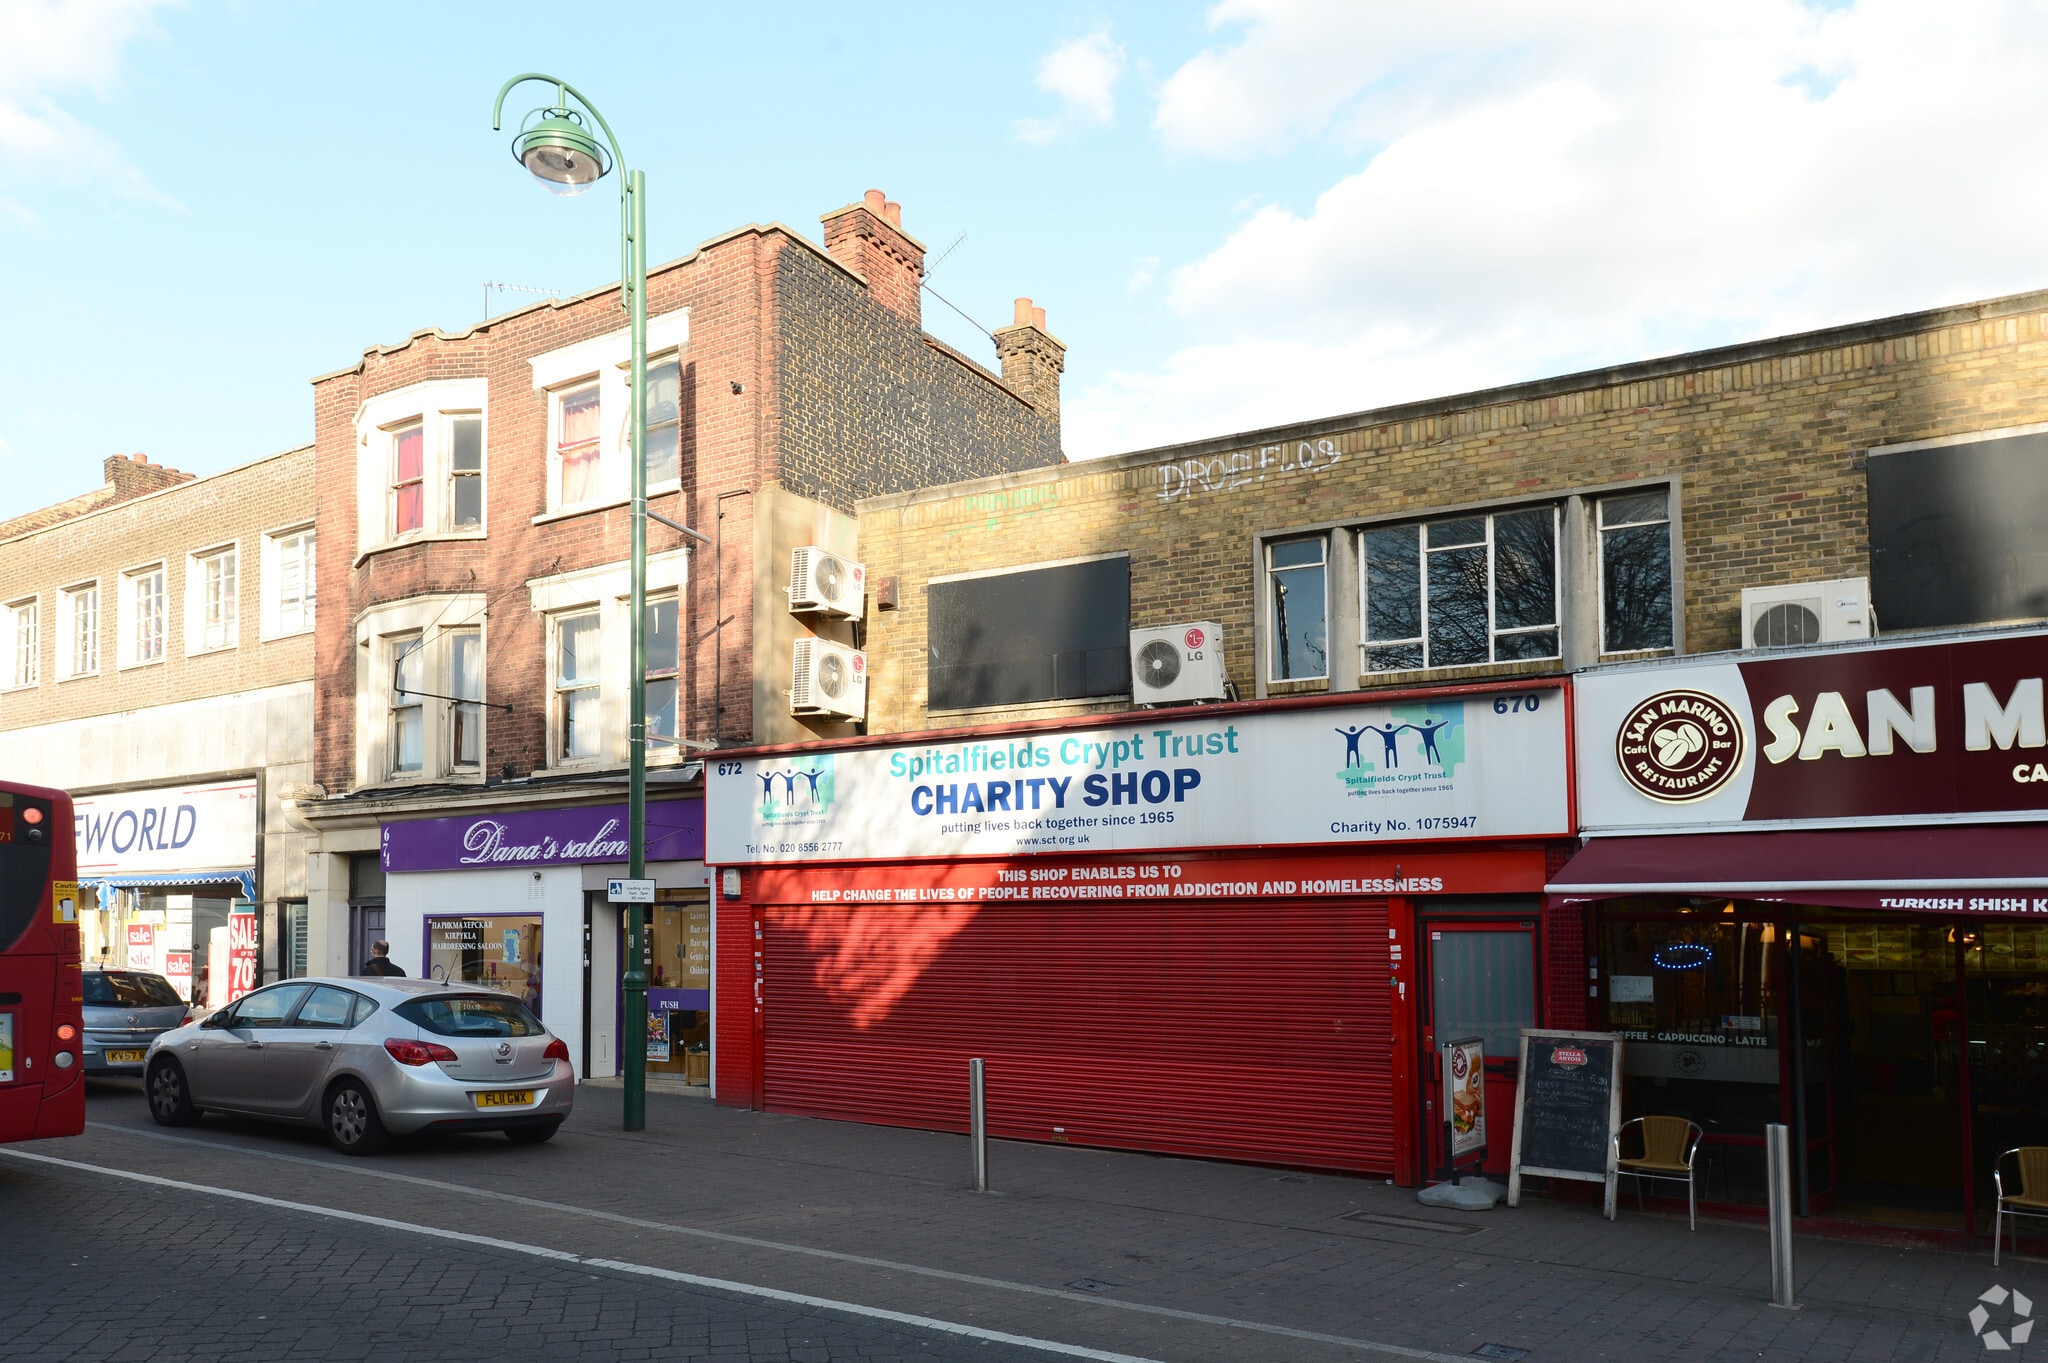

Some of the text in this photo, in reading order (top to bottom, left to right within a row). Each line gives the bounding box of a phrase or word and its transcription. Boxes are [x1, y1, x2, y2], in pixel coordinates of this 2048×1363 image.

[1187, 651, 1203, 661] LG
[852, 674, 862, 684] LG
[1493, 694, 1540, 714] 670
[1626, 699, 1728, 742] SAN MARINO
[1763, 677, 2048, 764] SAN M
[890, 725, 1239, 782] Spitalfields Crypt Trust
[1624, 740, 1732, 754] Café Bar
[718, 762, 742, 776] 672
[1635, 757, 1722, 789] RESTAURANT
[1345, 771, 1447, 786] Spitalfields Crypt Trust
[911, 768, 1201, 816] CHARITY SHOP
[1347, 784, 1454, 797] putting lives back together since 1965
[941, 811, 1175, 835] putting lives back together since 1965
[1330, 816, 1477, 835] Charity No. 1075947
[460, 819, 628, 864] Dana's salon
[745, 841, 843, 854] Tel. No. 020 8556 2777
[998, 865, 1182, 882] THIS SHOP ENABLES US TO
[811, 877, 1444, 902] HELP CHANGE THE LIVES OF PEOPLE RECOVERING FROM ADDICTION AND HOMELESSNESS
[1880, 898, 1963, 910] TURKISH
[1969, 898, 2027, 912] SHISH
[432, 921, 493, 929] ПАРИКМАХЕРСКАЯ
[129, 927, 151, 943] sale
[230, 917, 256, 950] SAL
[445, 932, 477, 940] KIRPYKLA
[167, 957, 190, 977] sale
[232, 958, 253, 990] 70
[660, 1001, 679, 1009] PUSH
[1657, 1032, 1725, 1044] CAPPUCCINO
[1736, 1036, 1767, 1045] LATTE
[485, 1092, 526, 1104] FL11 GWX
